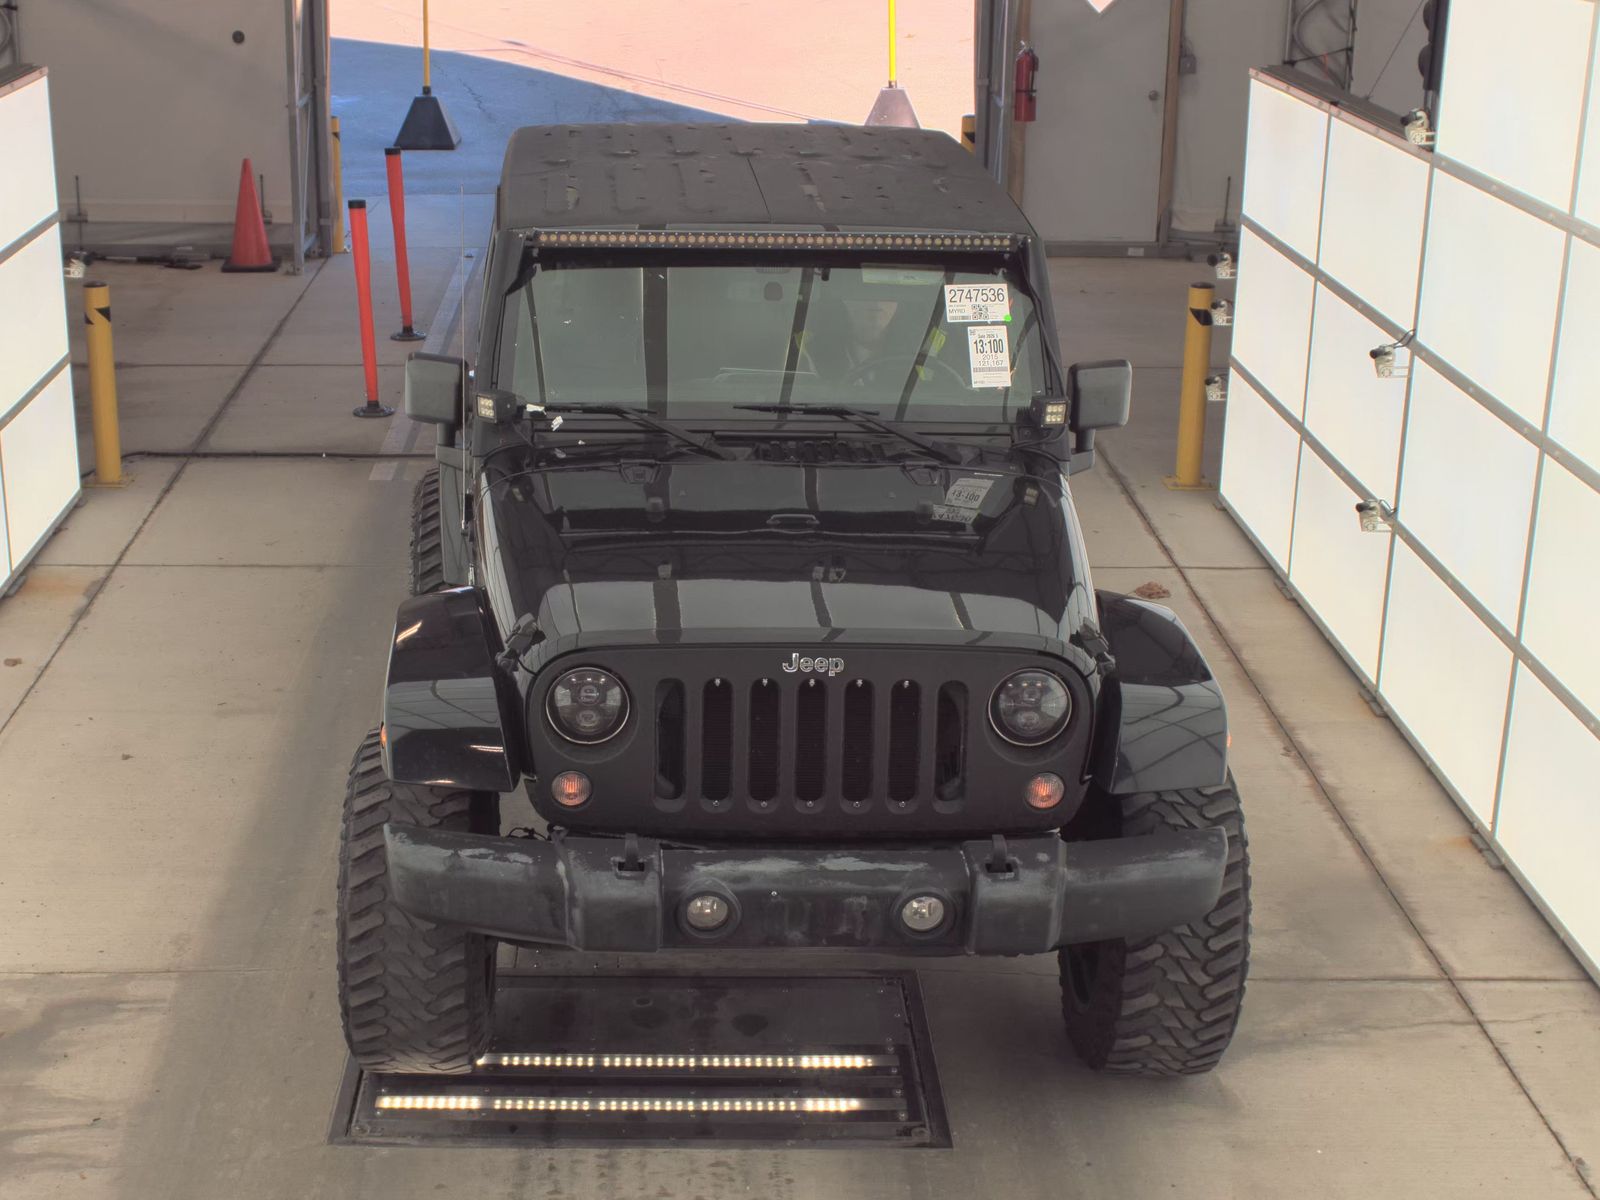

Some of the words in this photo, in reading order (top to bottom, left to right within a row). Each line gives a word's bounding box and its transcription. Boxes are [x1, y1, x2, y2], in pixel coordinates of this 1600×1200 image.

[949, 288, 1005, 303] 2747536
[974, 338, 1004, 354] 13:100
[782, 653, 845, 677] Jeep
